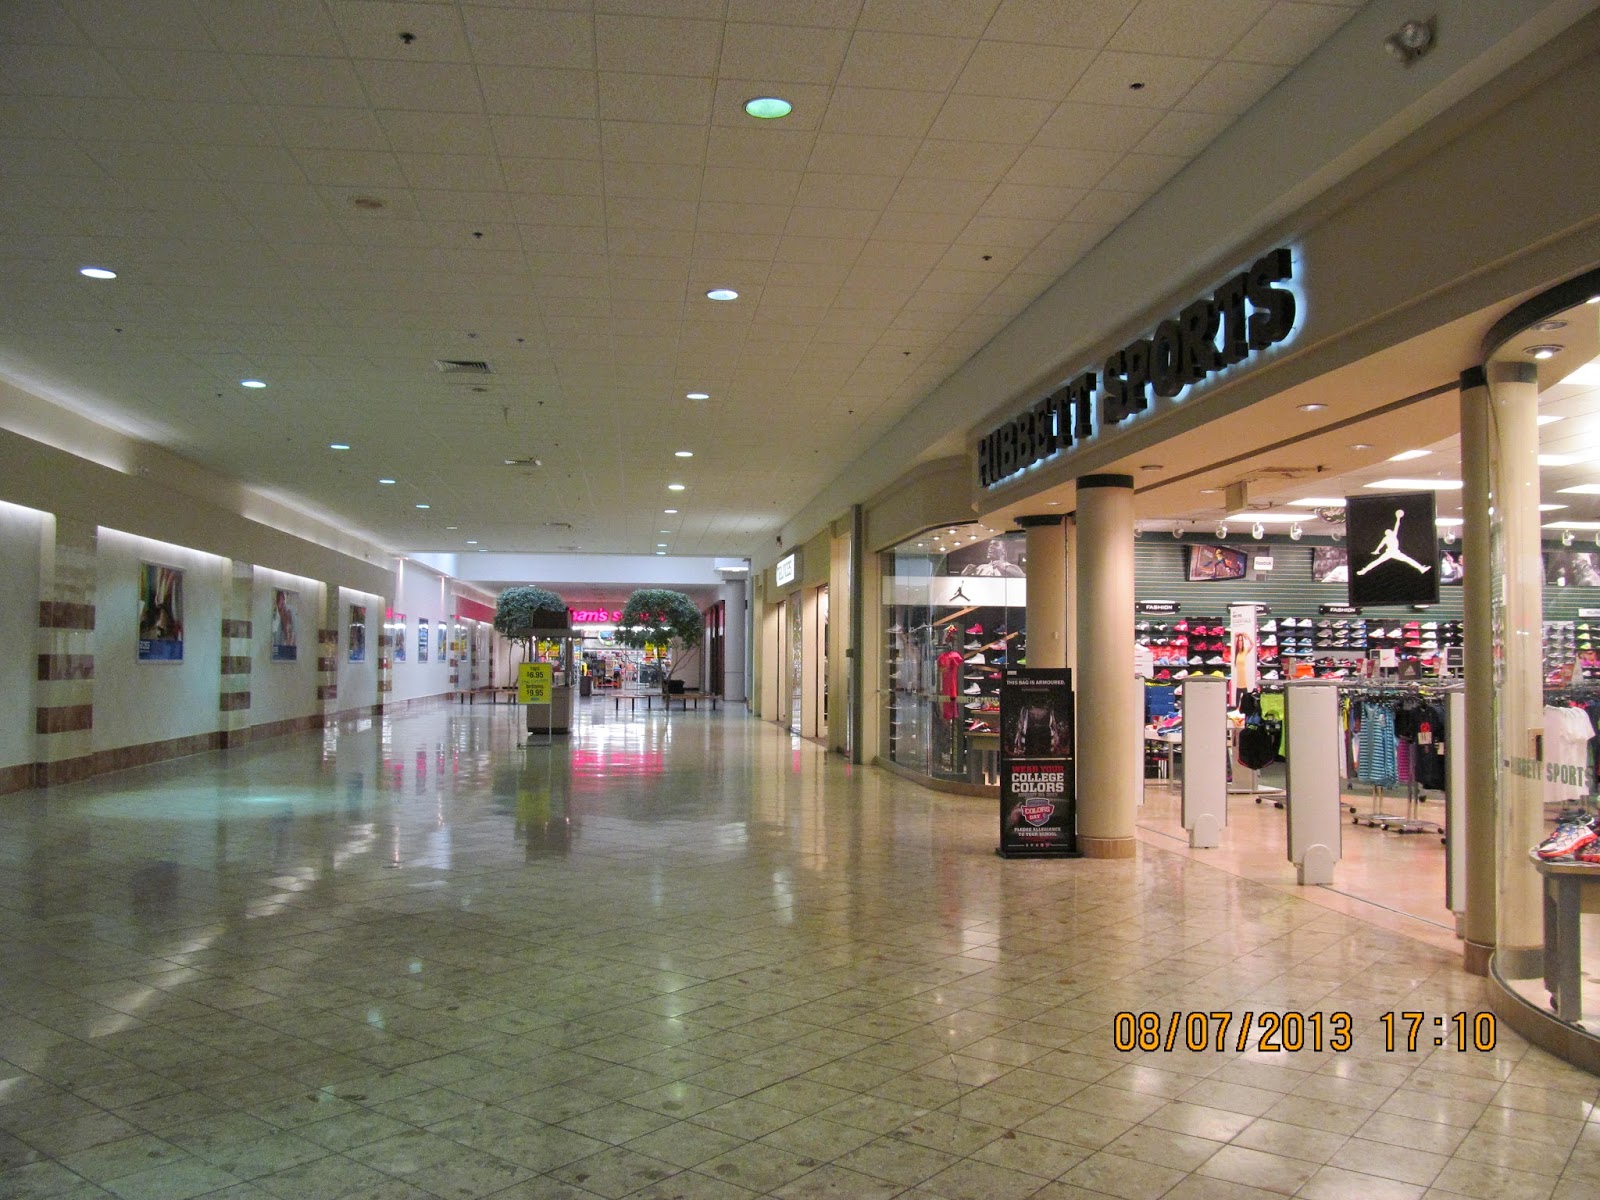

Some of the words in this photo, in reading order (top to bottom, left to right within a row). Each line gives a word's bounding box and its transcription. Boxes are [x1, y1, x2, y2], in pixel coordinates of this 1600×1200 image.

[978, 372, 1097, 487] HIBBETT
[1103, 248, 1297, 425] SPORTS
[526, 671, 544, 679] $6.95
[526, 689, 544, 697] $9.95
[1011, 765, 1038, 773] WEAR
[1040, 765, 1065, 773] YOUR
[1011, 772, 1064, 783] COLLEGE
[1546, 761, 1594, 790] SPORTS
[1011, 782, 1065, 793] COLORS
[1024, 806, 1051, 815] COLORS
